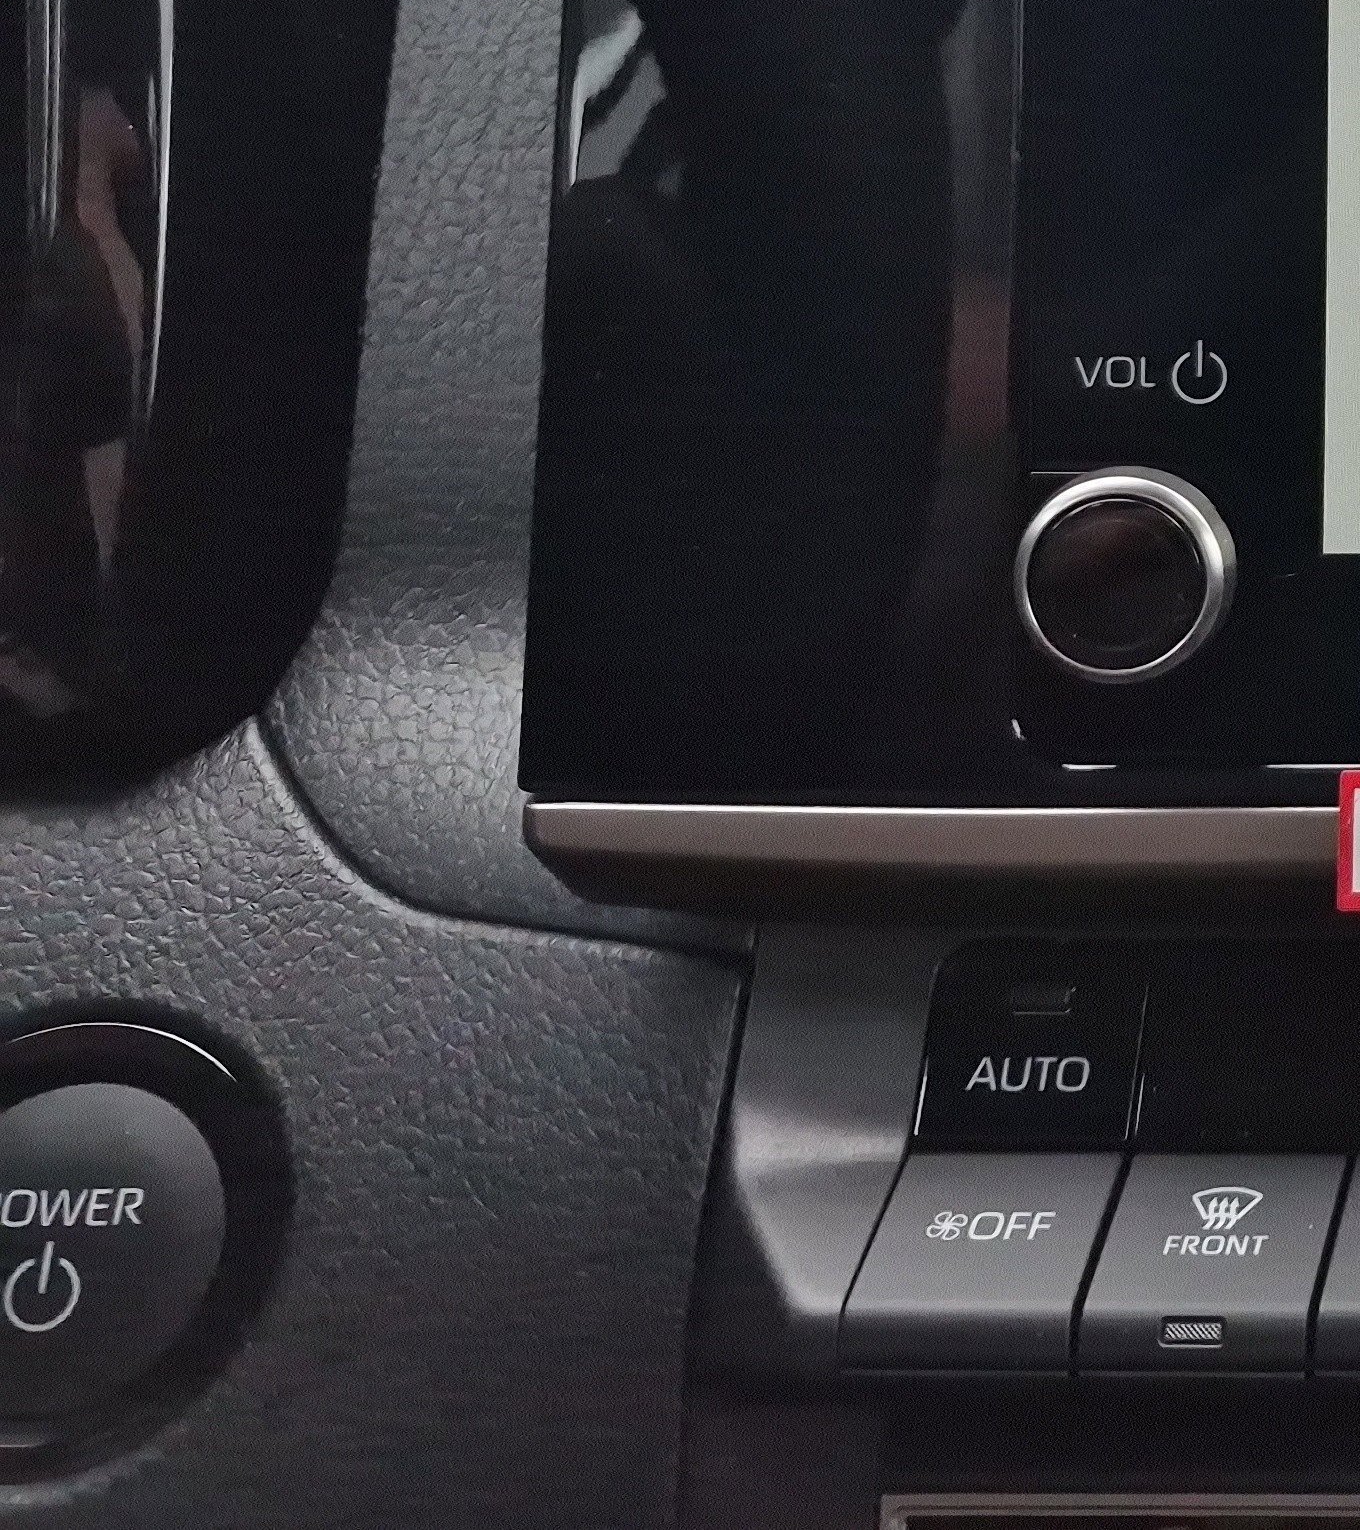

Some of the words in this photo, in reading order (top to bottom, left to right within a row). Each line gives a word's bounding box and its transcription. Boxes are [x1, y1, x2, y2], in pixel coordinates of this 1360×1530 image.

[1074, 355, 1155, 389] VOL
[965, 1056, 1091, 1093] AUTO
[0, 1187, 145, 1228] OWER
[967, 1210, 1056, 1242] OFF
[1162, 1234, 1267, 1257] FRONT
